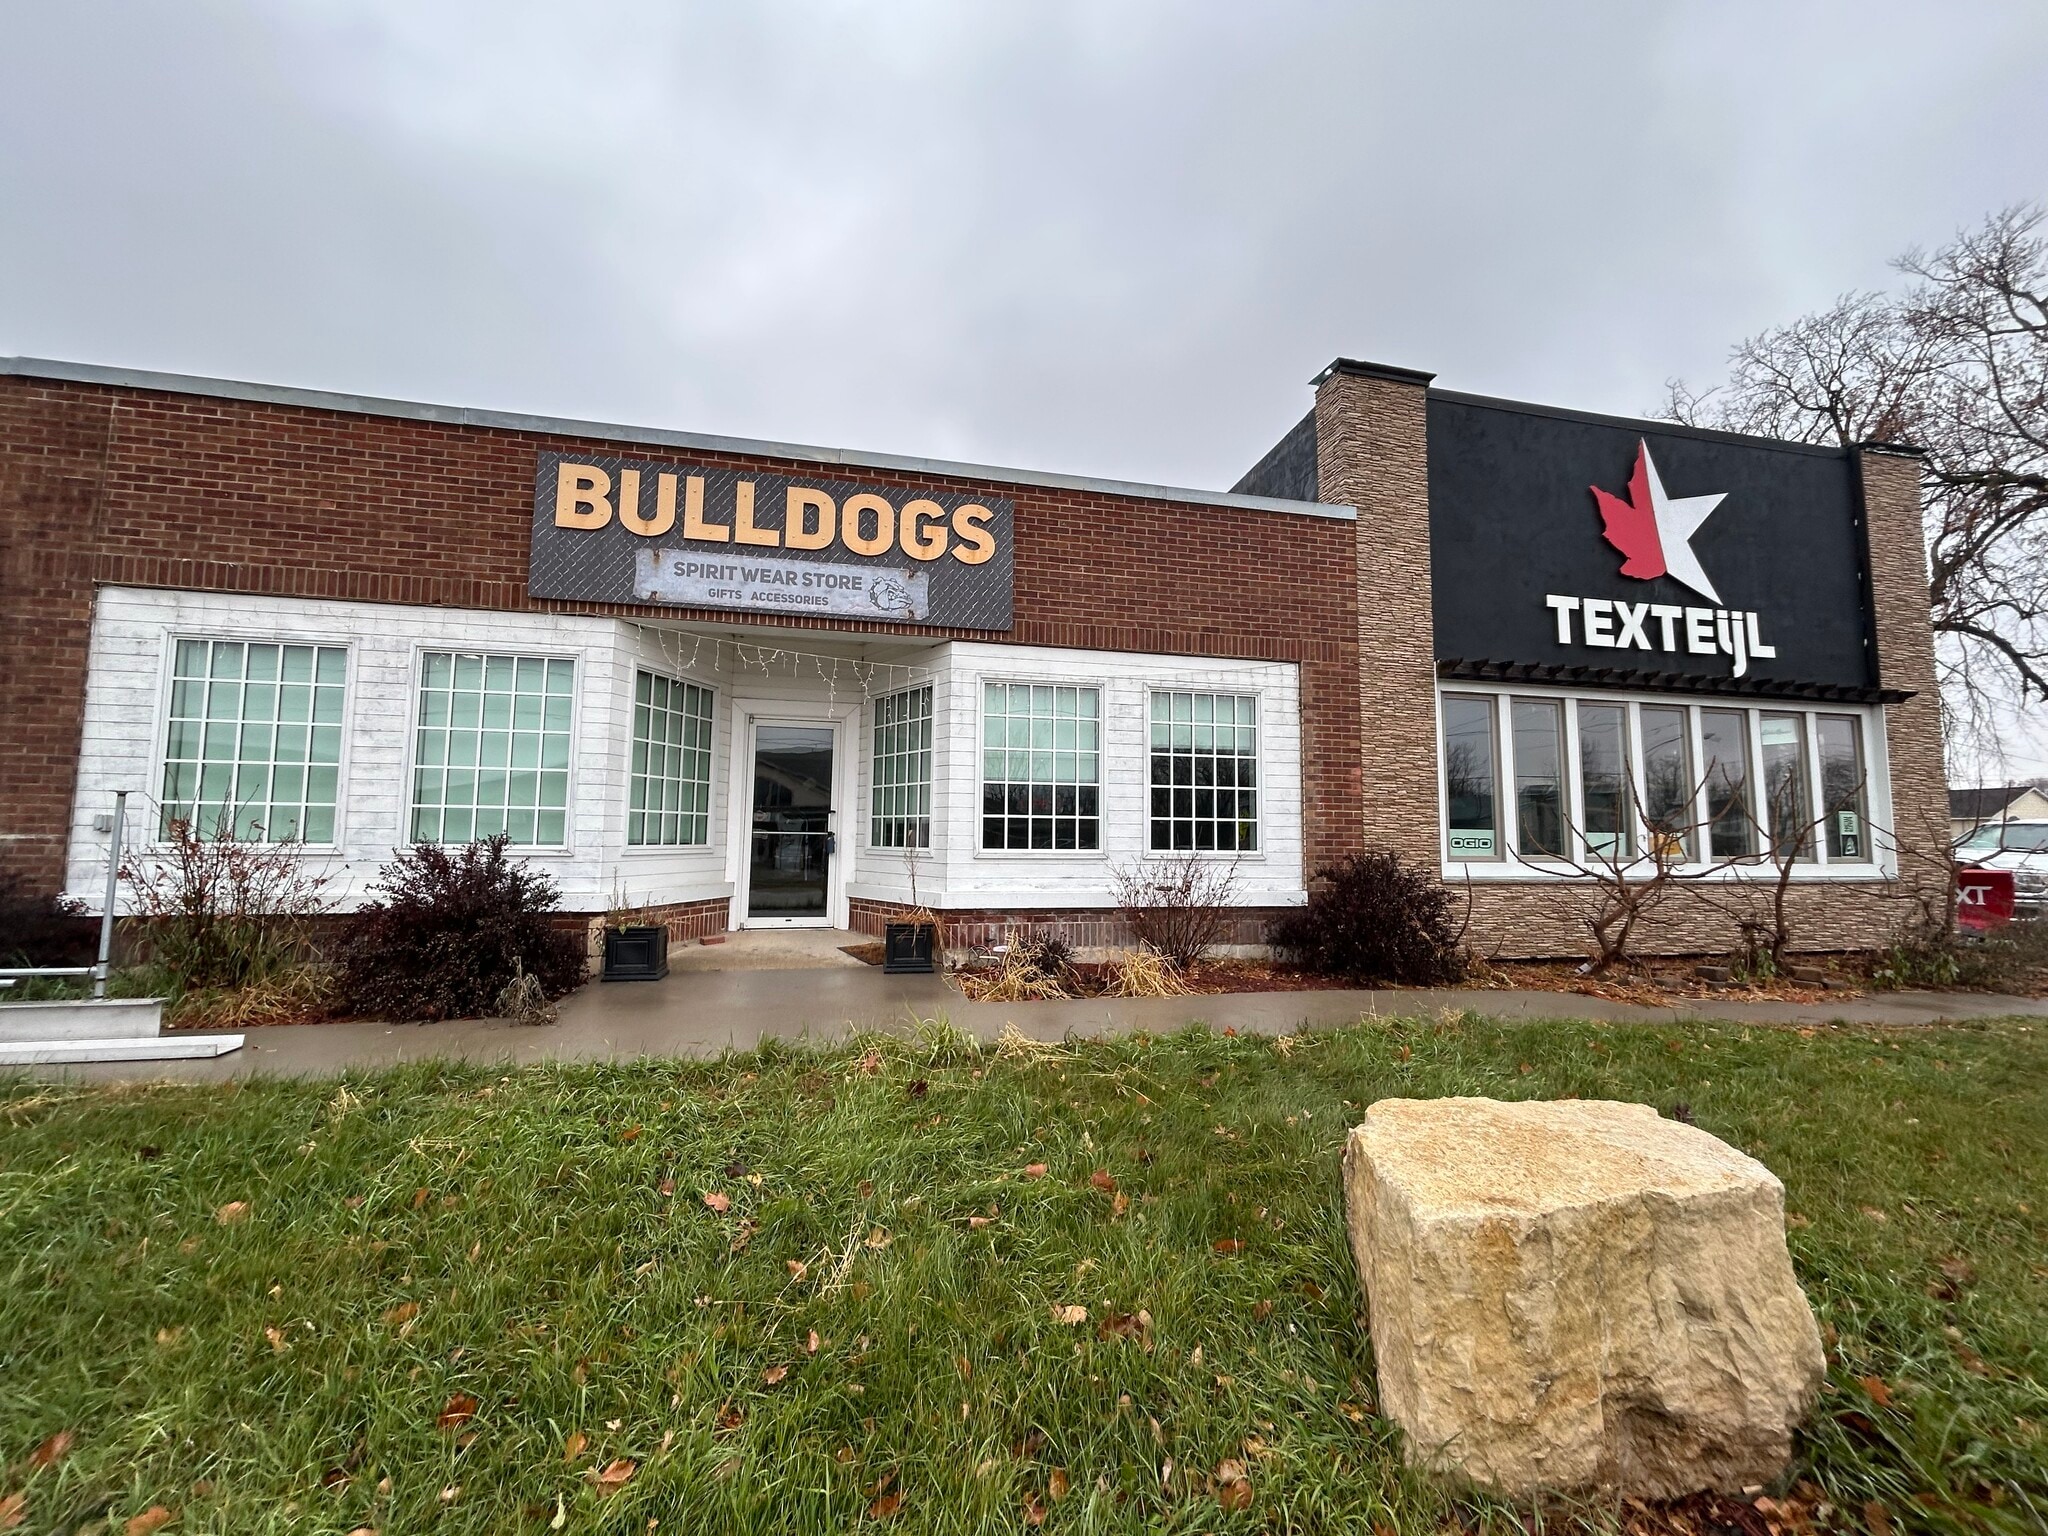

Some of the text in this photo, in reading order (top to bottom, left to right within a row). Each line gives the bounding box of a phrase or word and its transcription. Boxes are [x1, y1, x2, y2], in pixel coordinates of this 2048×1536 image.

[554, 462, 996, 566] BULLDOGS
[673, 561, 863, 591] SPIRIT WEAR STORE
[708, 588, 829, 606] GIFTS ACCESSORIES
[1450, 837, 1493, 850] OGIO
